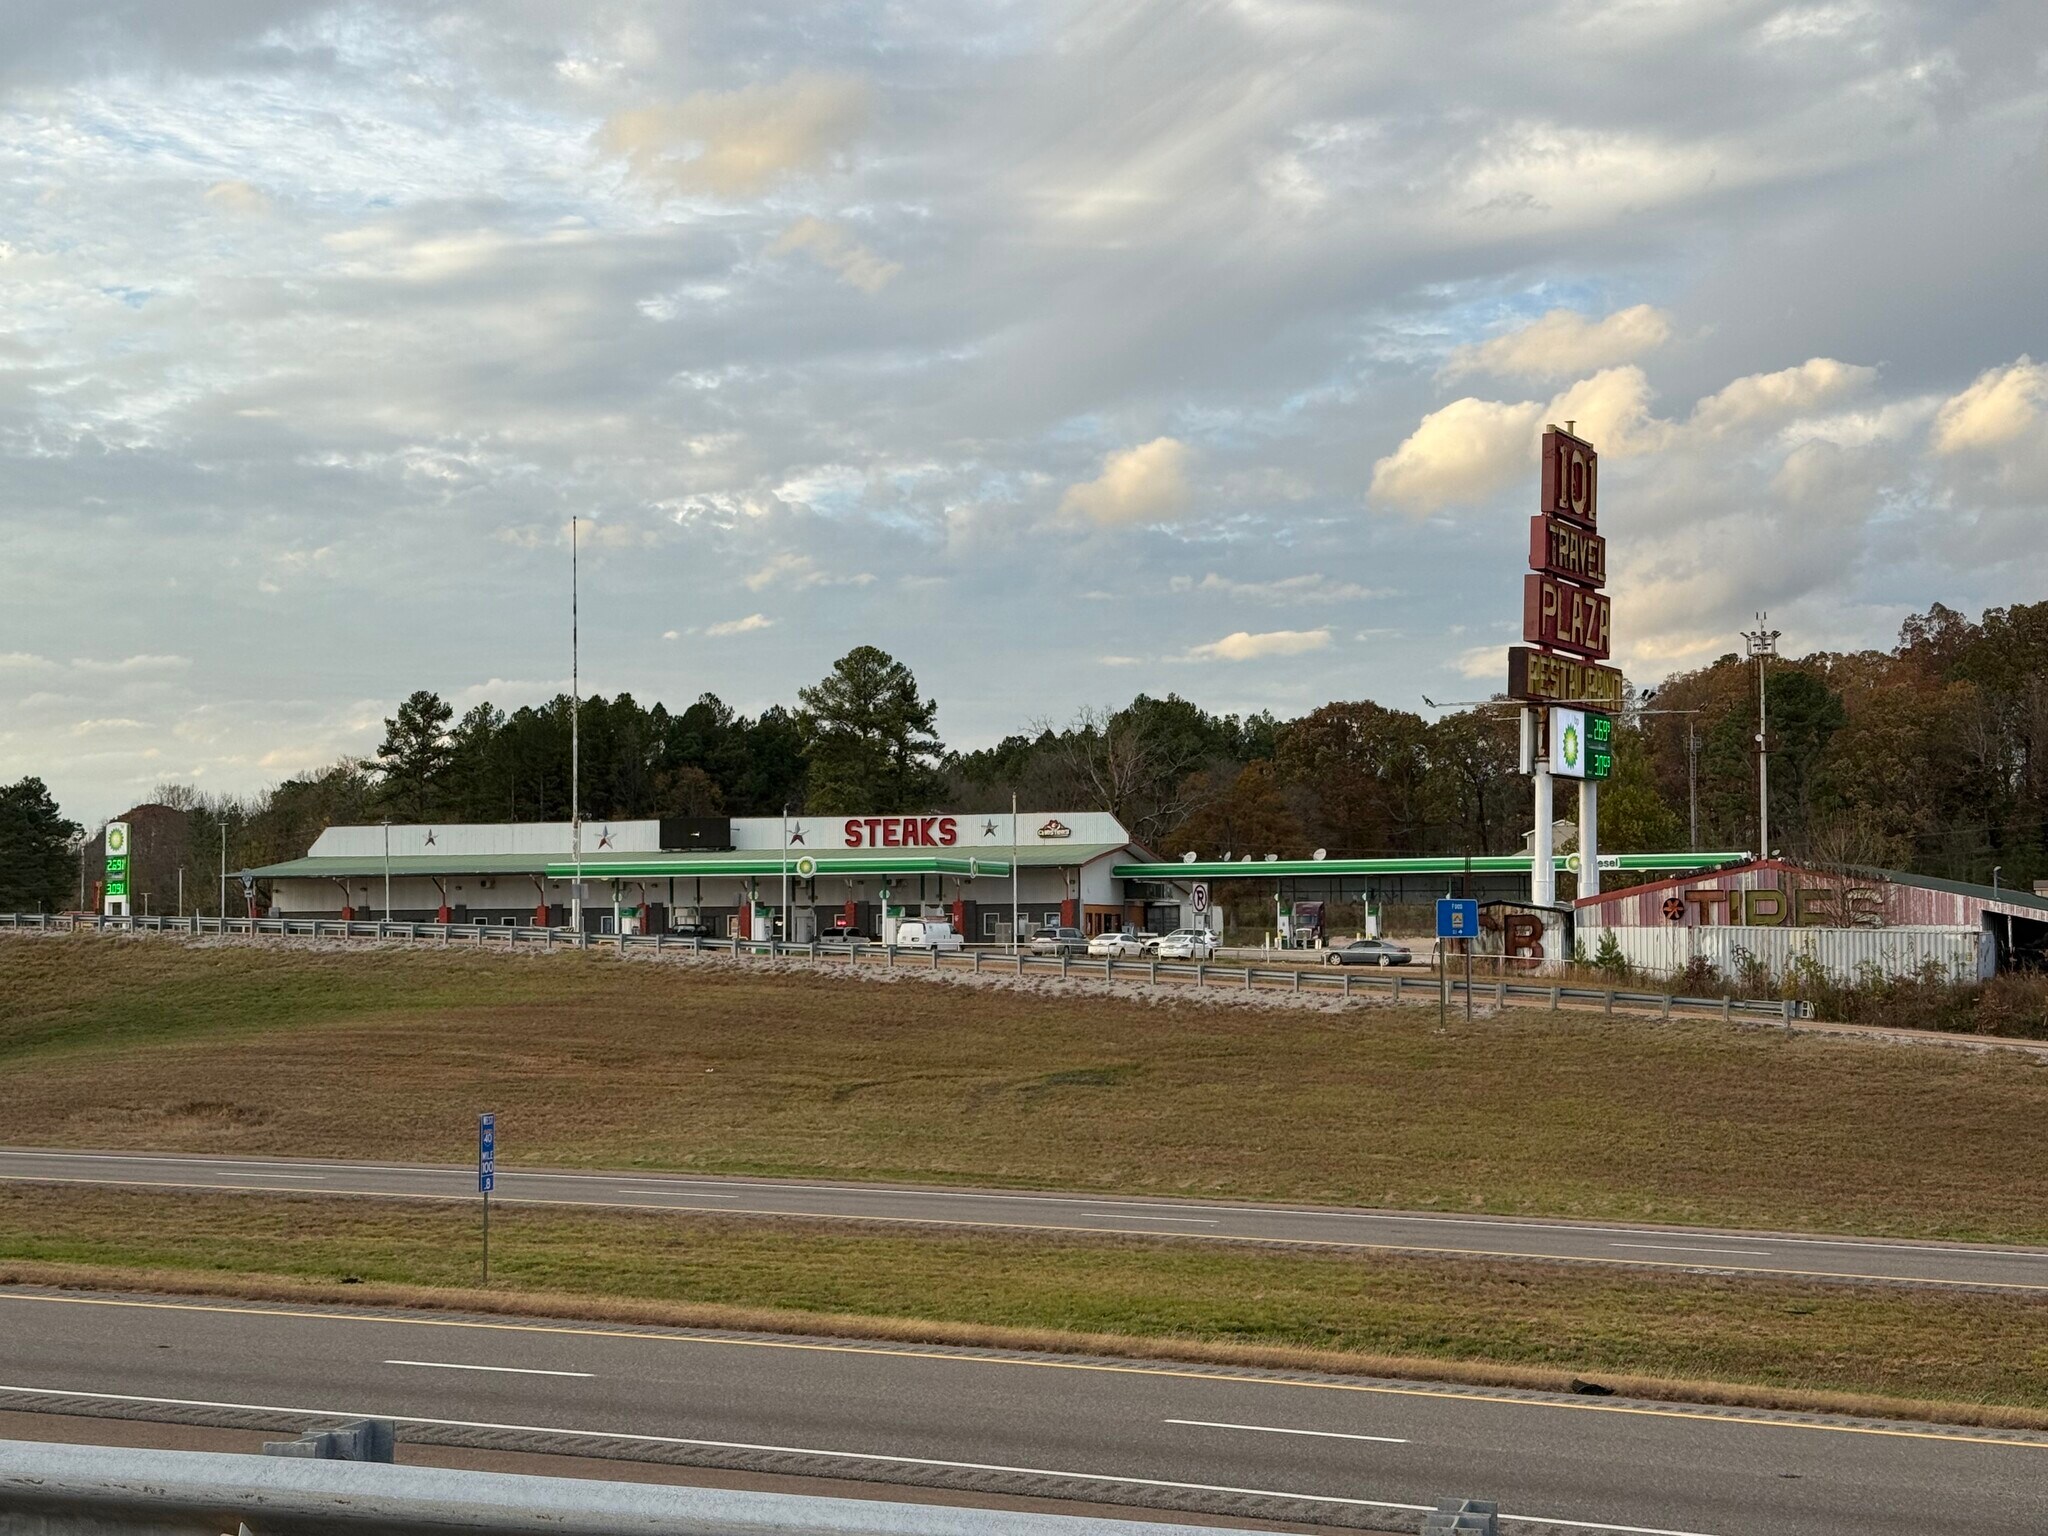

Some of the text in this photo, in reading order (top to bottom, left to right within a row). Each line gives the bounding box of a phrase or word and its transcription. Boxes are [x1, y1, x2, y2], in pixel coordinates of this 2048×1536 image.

[1559, 444, 1597, 520] 101
[1549, 523, 1606, 582] TRAVEL
[1541, 582, 1610, 654] PLAZA
[845, 817, 957, 847] STEAKS
[1597, 857, 1618, 868] esel
[483, 1133, 493, 1143] 40
[482, 1151, 493, 1160] MILE
[482, 1161, 493, 1173] 100
